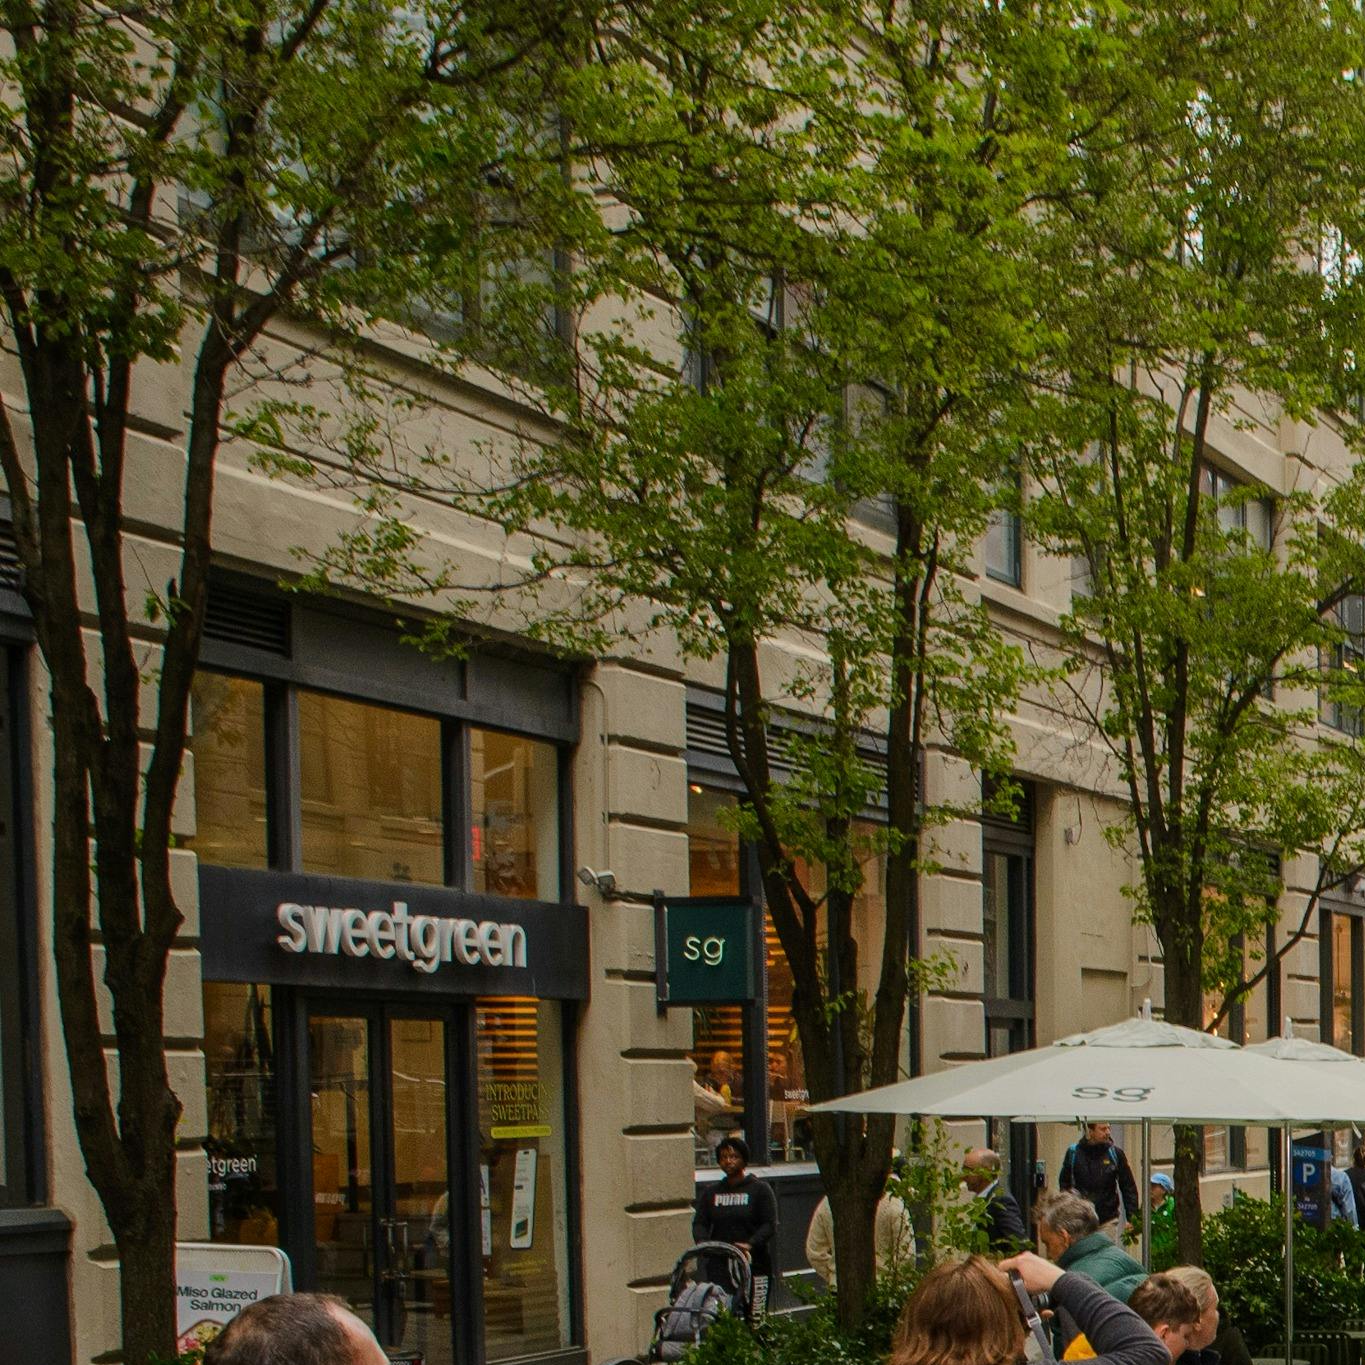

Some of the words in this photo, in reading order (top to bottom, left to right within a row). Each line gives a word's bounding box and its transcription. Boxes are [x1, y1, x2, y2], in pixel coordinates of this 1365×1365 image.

[277, 902, 527, 973] sweetgreen
[684, 935, 726, 966] sg
[486, 1083, 553, 1101] INTRODUCIN
[1072, 1086, 1155, 1103] sg
[1303, 1163, 1316, 1183] P
[714, 1193, 749, 1207] PUMA
[176, 1286, 209, 1298] Miso
[211, 1287, 258, 1300] Glazed
[190, 1300, 241, 1312] Salmon
